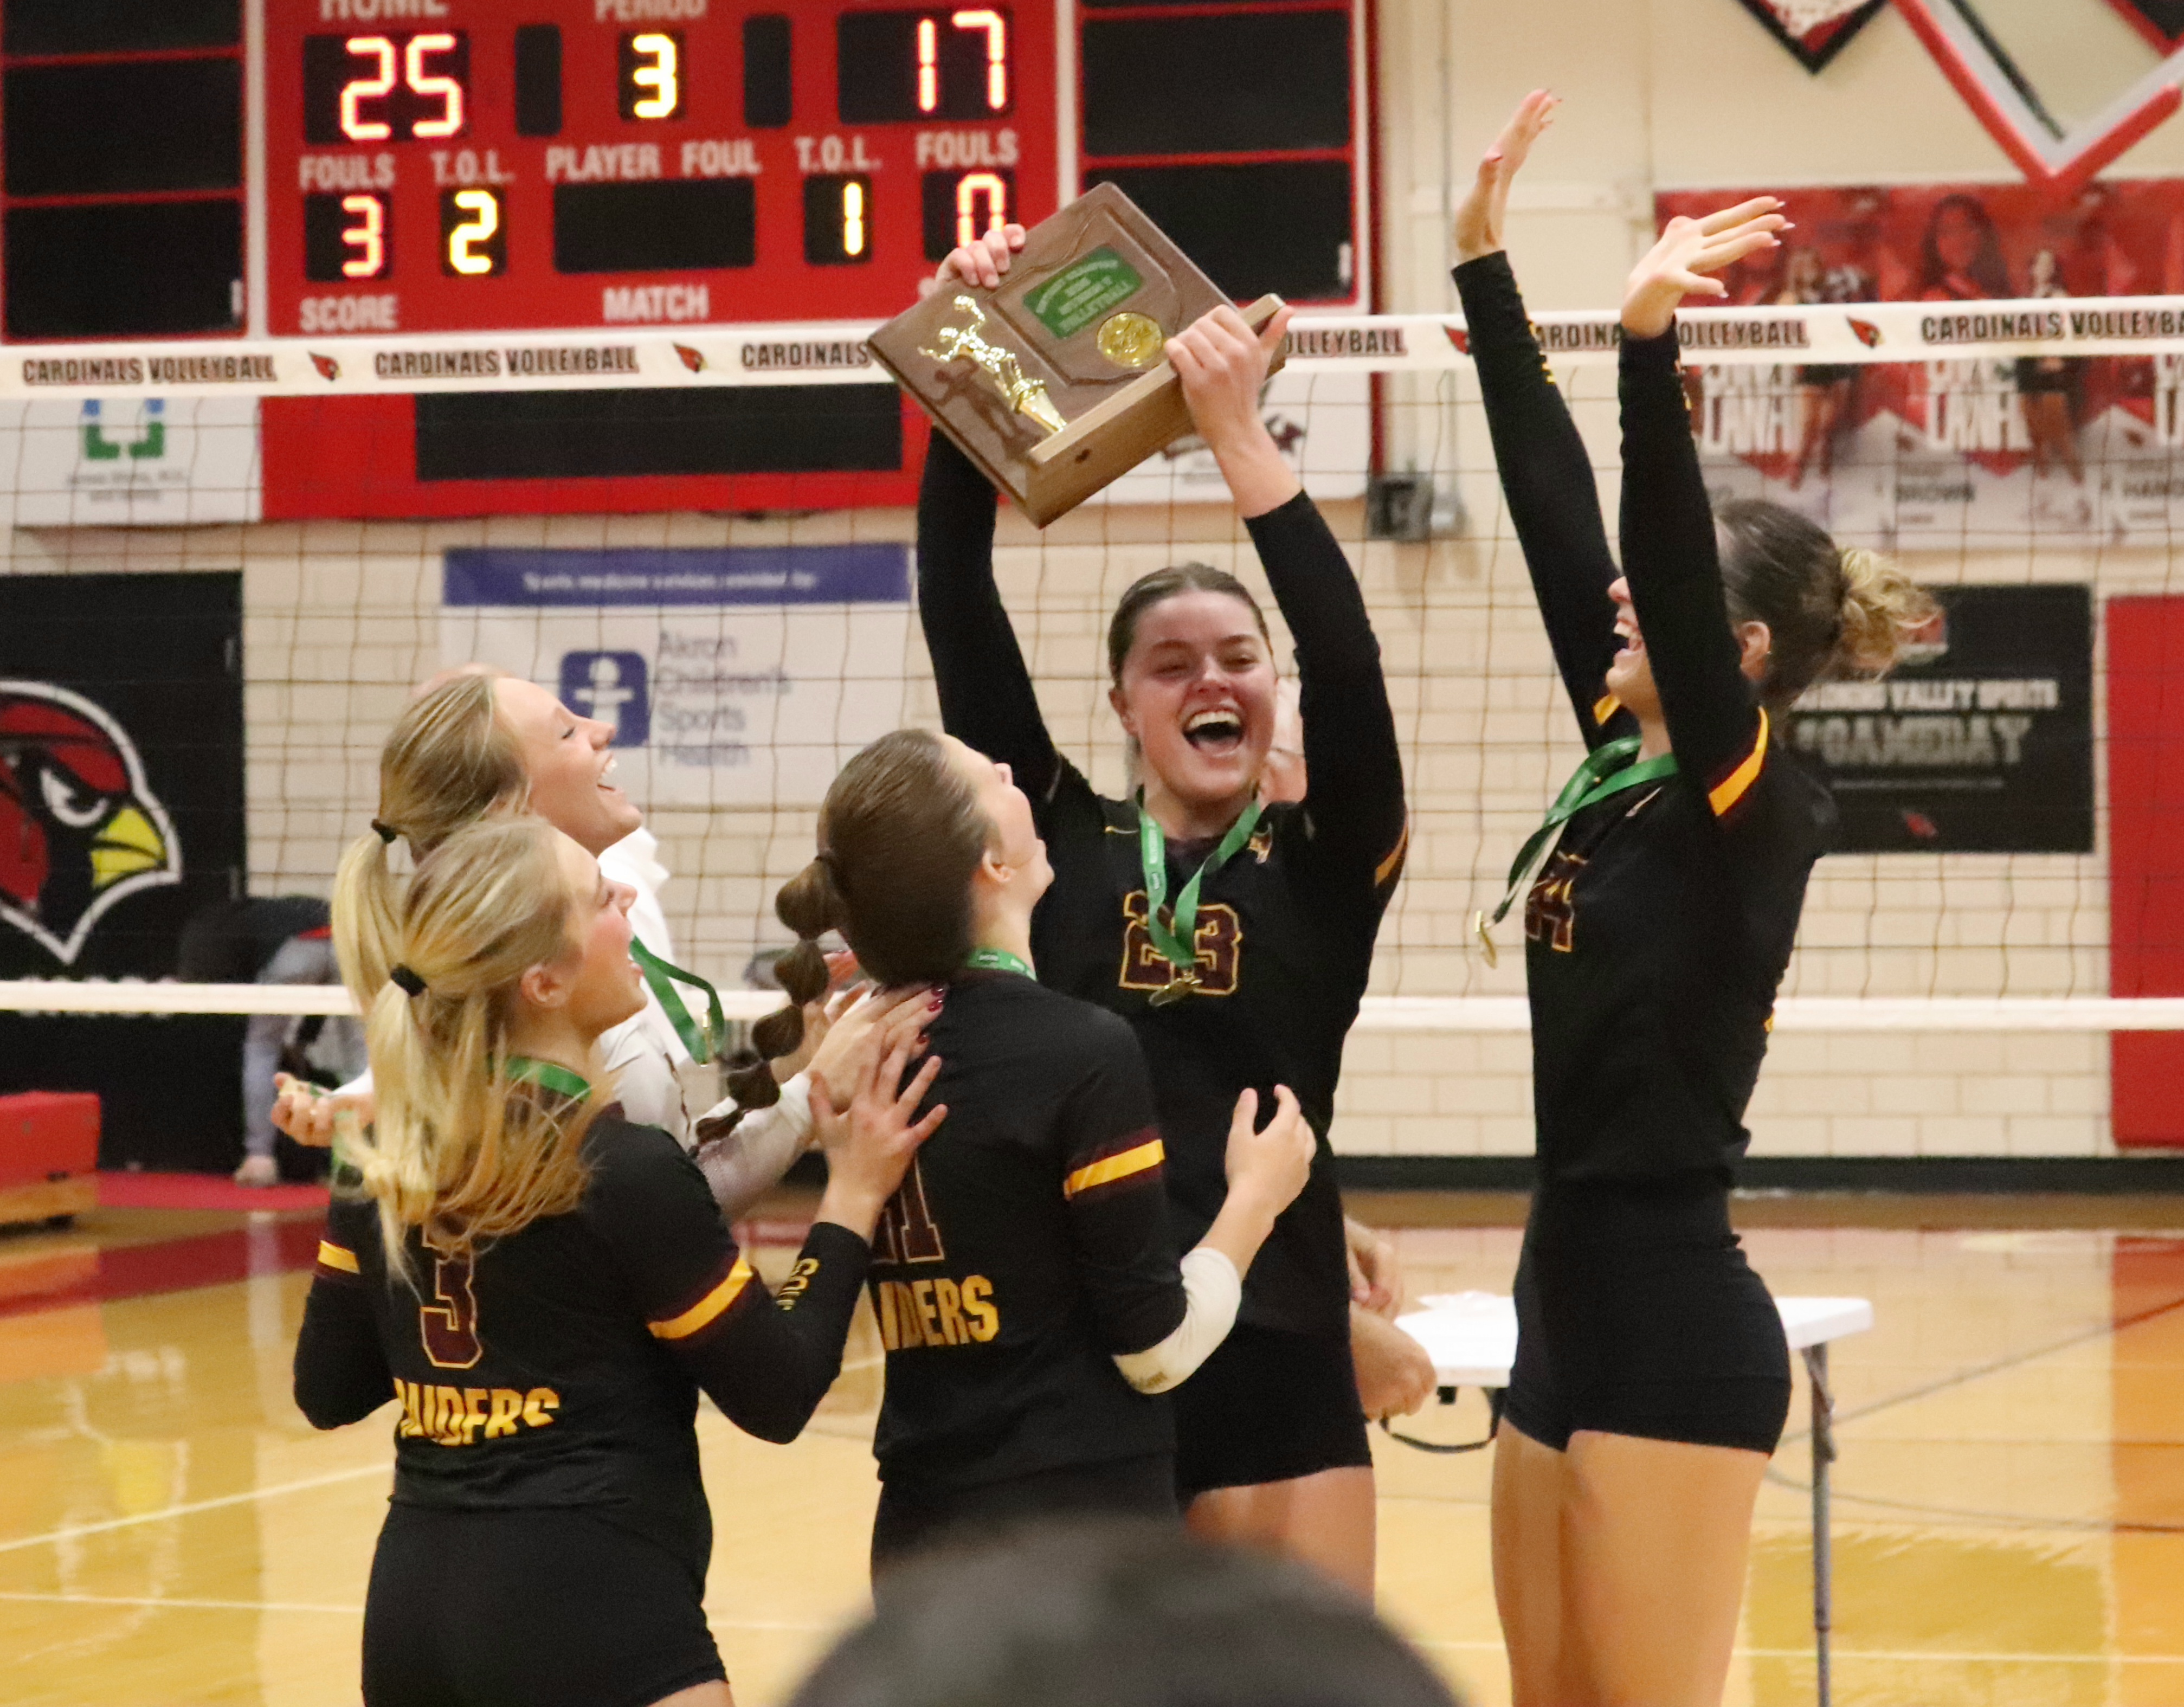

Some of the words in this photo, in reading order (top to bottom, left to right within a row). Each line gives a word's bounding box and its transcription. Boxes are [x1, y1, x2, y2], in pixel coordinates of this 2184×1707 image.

[633, 34, 678, 118] 3
[918, 11, 1006, 112] 17
[341, 34, 463, 140] 25
[431, 150, 514, 184] T.O.L.
[546, 143, 660, 181] PLAYER
[681, 138, 762, 178] FOUL
[795, 134, 882, 171] T.O.L.
[916, 130, 1019, 168] FOULS
[300, 153, 395, 190] FOULS
[342, 195, 383, 277] 3
[450, 191, 498, 274] 2
[844, 182, 863, 255] 1
[300, 295, 398, 331] SCORE
[603, 285, 709, 321] MATCH
[1286, 328, 1408, 358] OLLEYBALL
[1679, 319, 1809, 350] OLLEYBALL
[1922, 312, 2065, 344] CARDINALS
[2070, 309, 2184, 340] VOLLEYBA
[23, 358, 144, 385] CARDINALS
[149, 355, 276, 383] VOLLEYBALL
[375, 350, 500, 379] CARDINALS
[506, 346, 639, 376] VOLLEYBALL
[742, 341, 872, 372] CARDINALS
[1118, 890, 1243, 997] 23
[879, 1274, 1000, 1351] IDERS
